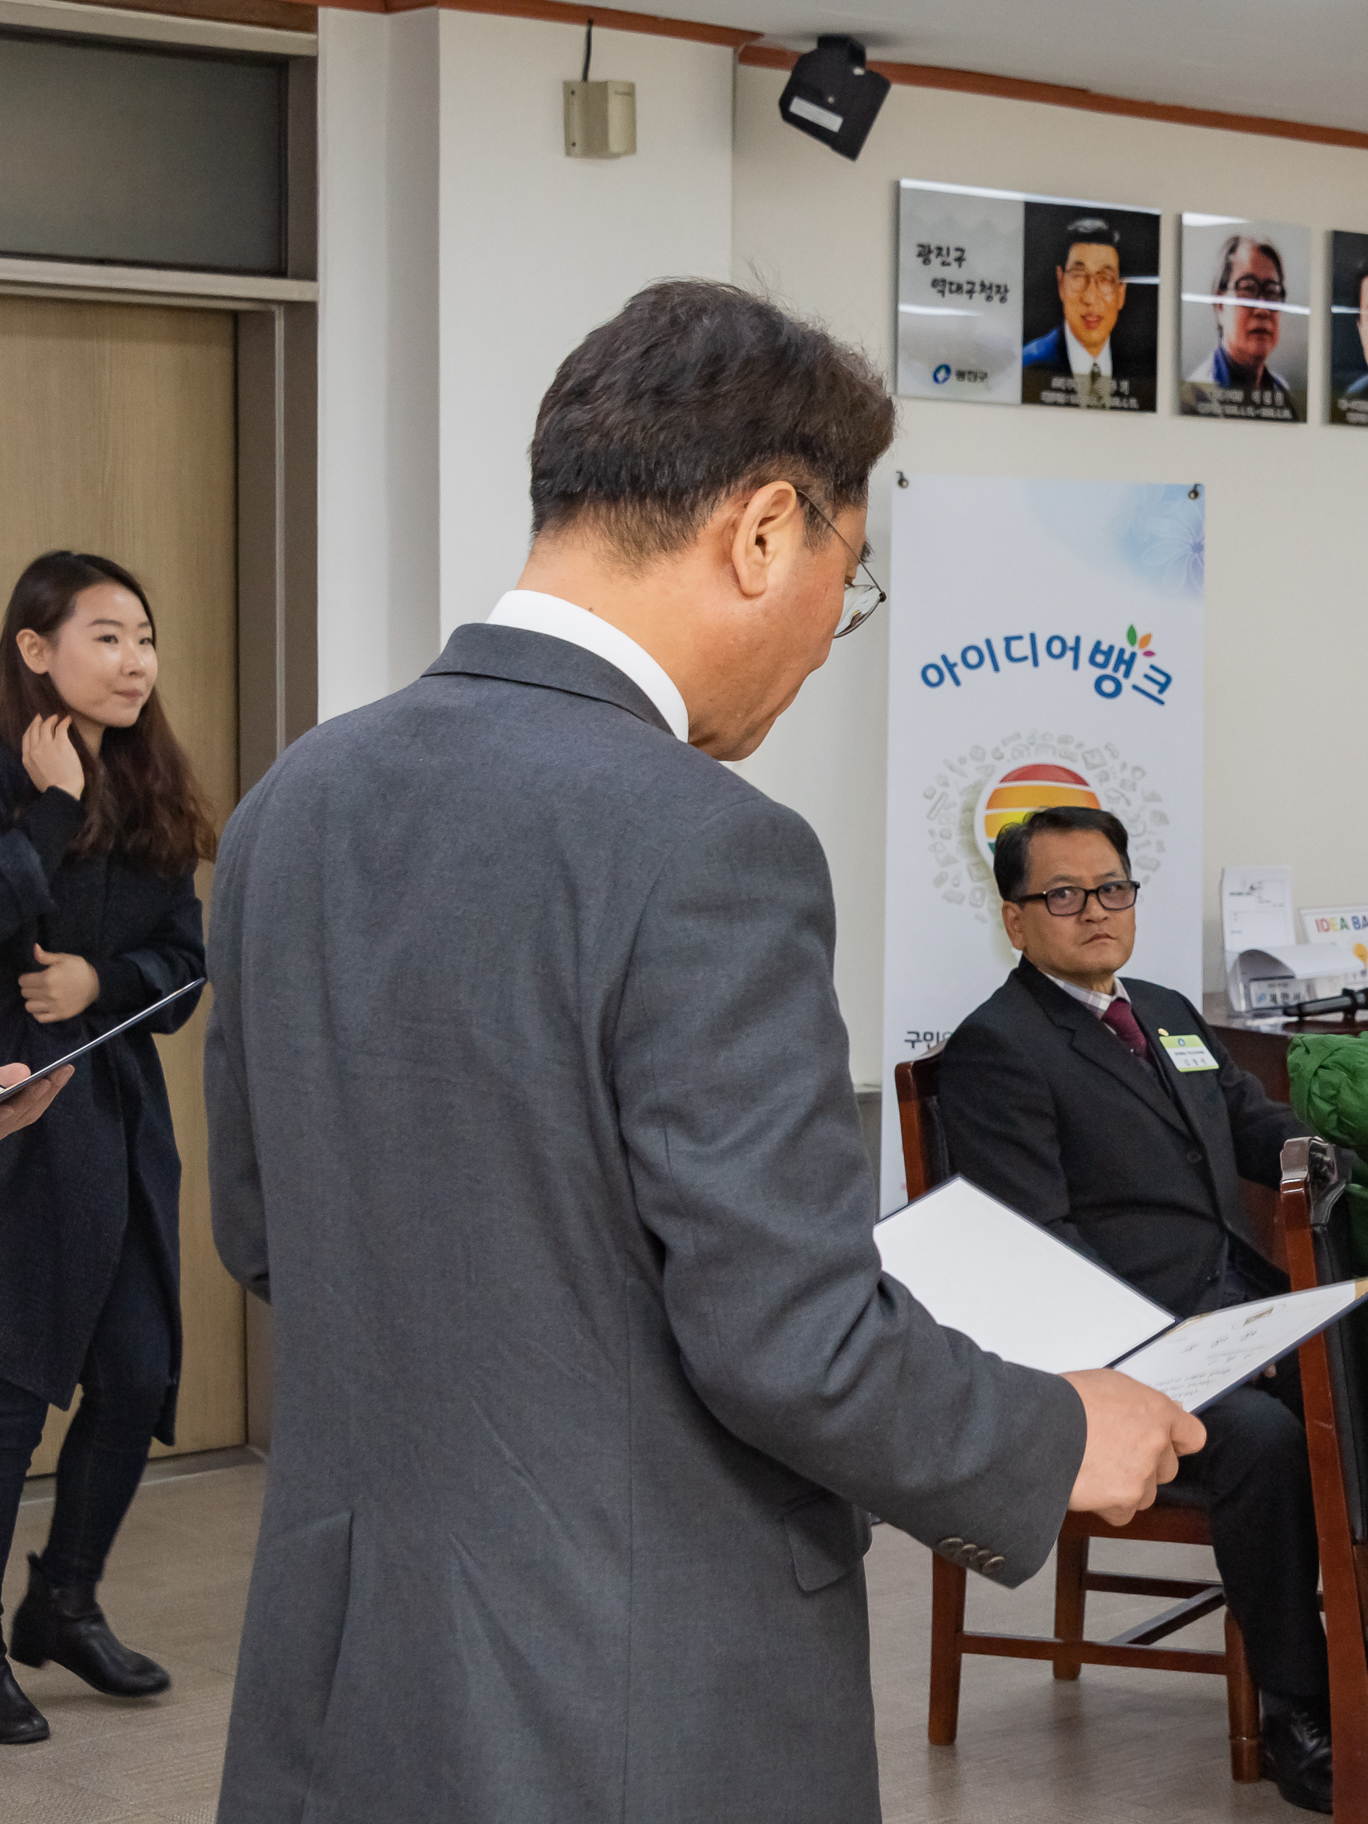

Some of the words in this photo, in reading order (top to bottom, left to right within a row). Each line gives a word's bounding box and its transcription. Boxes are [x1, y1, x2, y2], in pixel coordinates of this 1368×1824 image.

[916, 243, 967, 269] 광진구
[920, 632, 1173, 706] 아이디어뱅크
[1315, 917, 1350, 933] IDEA
